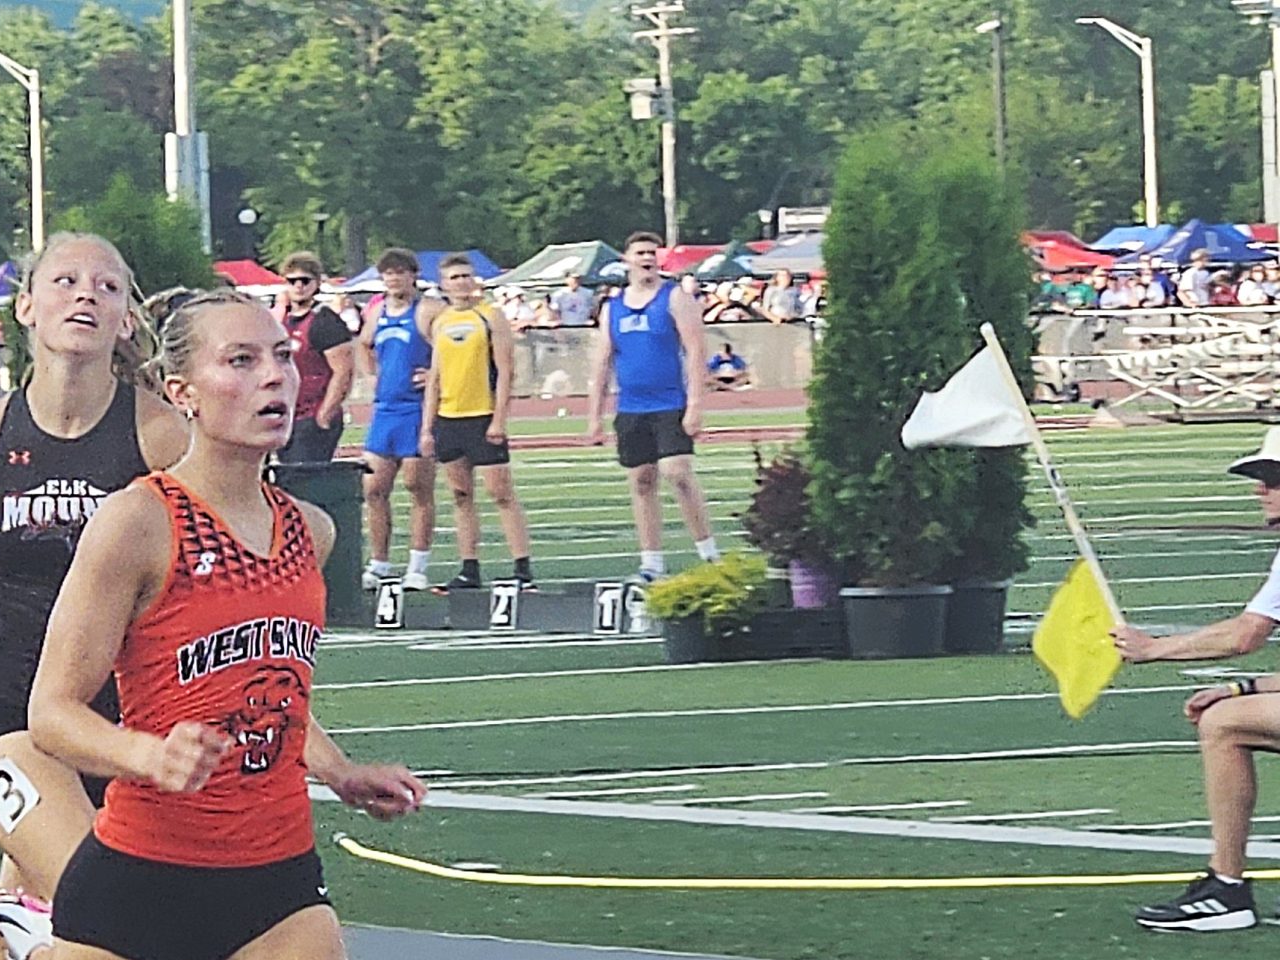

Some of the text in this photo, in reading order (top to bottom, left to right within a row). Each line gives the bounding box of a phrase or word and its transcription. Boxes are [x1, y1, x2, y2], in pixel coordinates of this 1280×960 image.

[46, 480, 87, 496] ELK
[376, 584, 400, 622] 4
[492, 585, 515, 623] 2
[598, 588, 620, 630] 1
[177, 617, 269, 685] WEST
